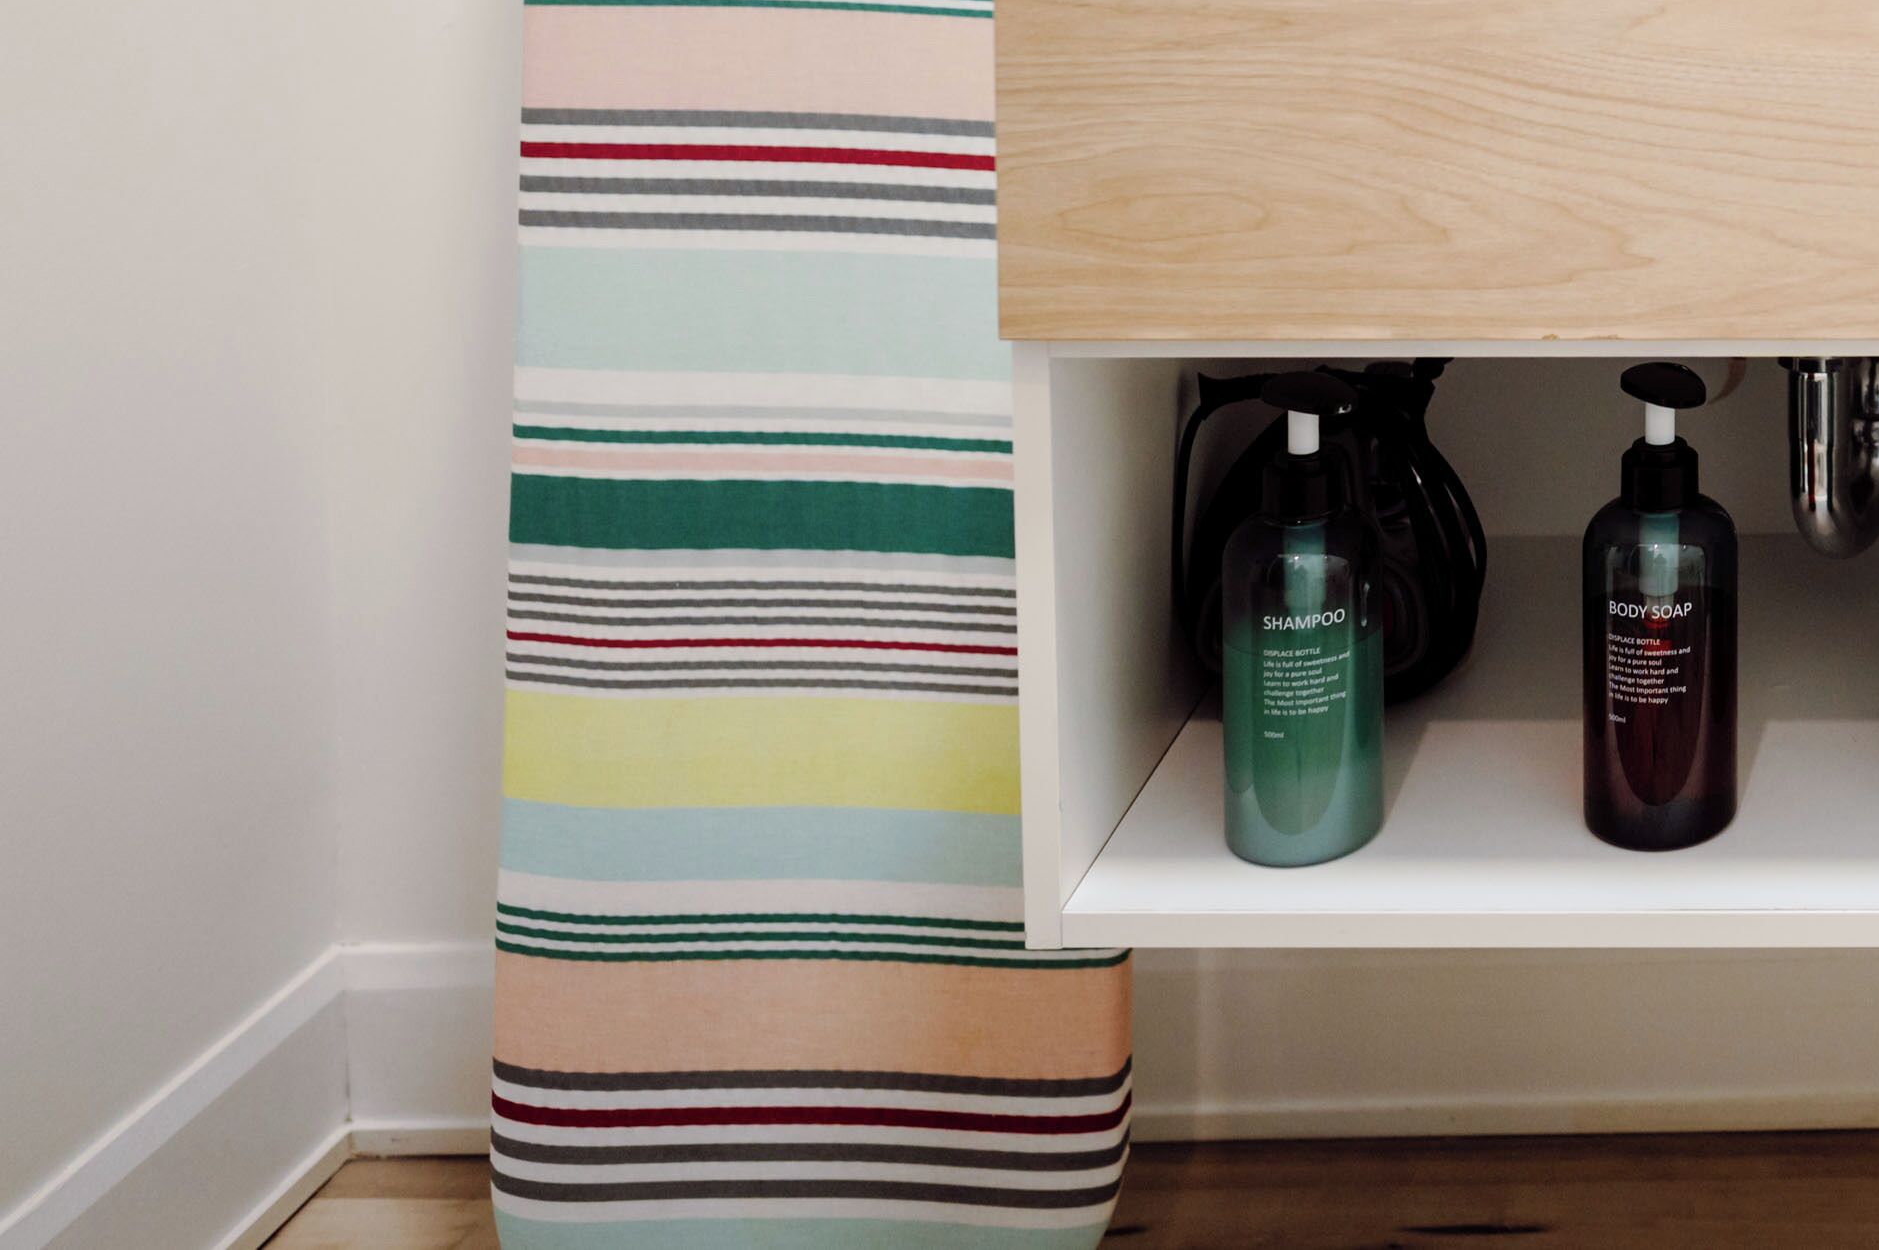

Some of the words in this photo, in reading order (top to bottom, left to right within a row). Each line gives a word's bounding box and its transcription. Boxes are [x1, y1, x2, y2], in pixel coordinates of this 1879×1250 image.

[1609, 601, 1648, 618] BODY
[1651, 602, 1693, 620] SOAP
[1263, 608, 1346, 630] SHAMPOO
[1608, 633, 1635, 644] DISPLACE
[1636, 638, 1660, 646] BOTTLE
[1608, 644, 1617, 652] Life
[1678, 646, 1691, 654] and
[1608, 663, 1624, 671] Learn
[1609, 673, 1635, 684] challenge
[1637, 678, 1664, 686] together
[1609, 682, 1618, 690] The
[1620, 685, 1635, 693] Most
[1648, 697, 1669, 705] happy
